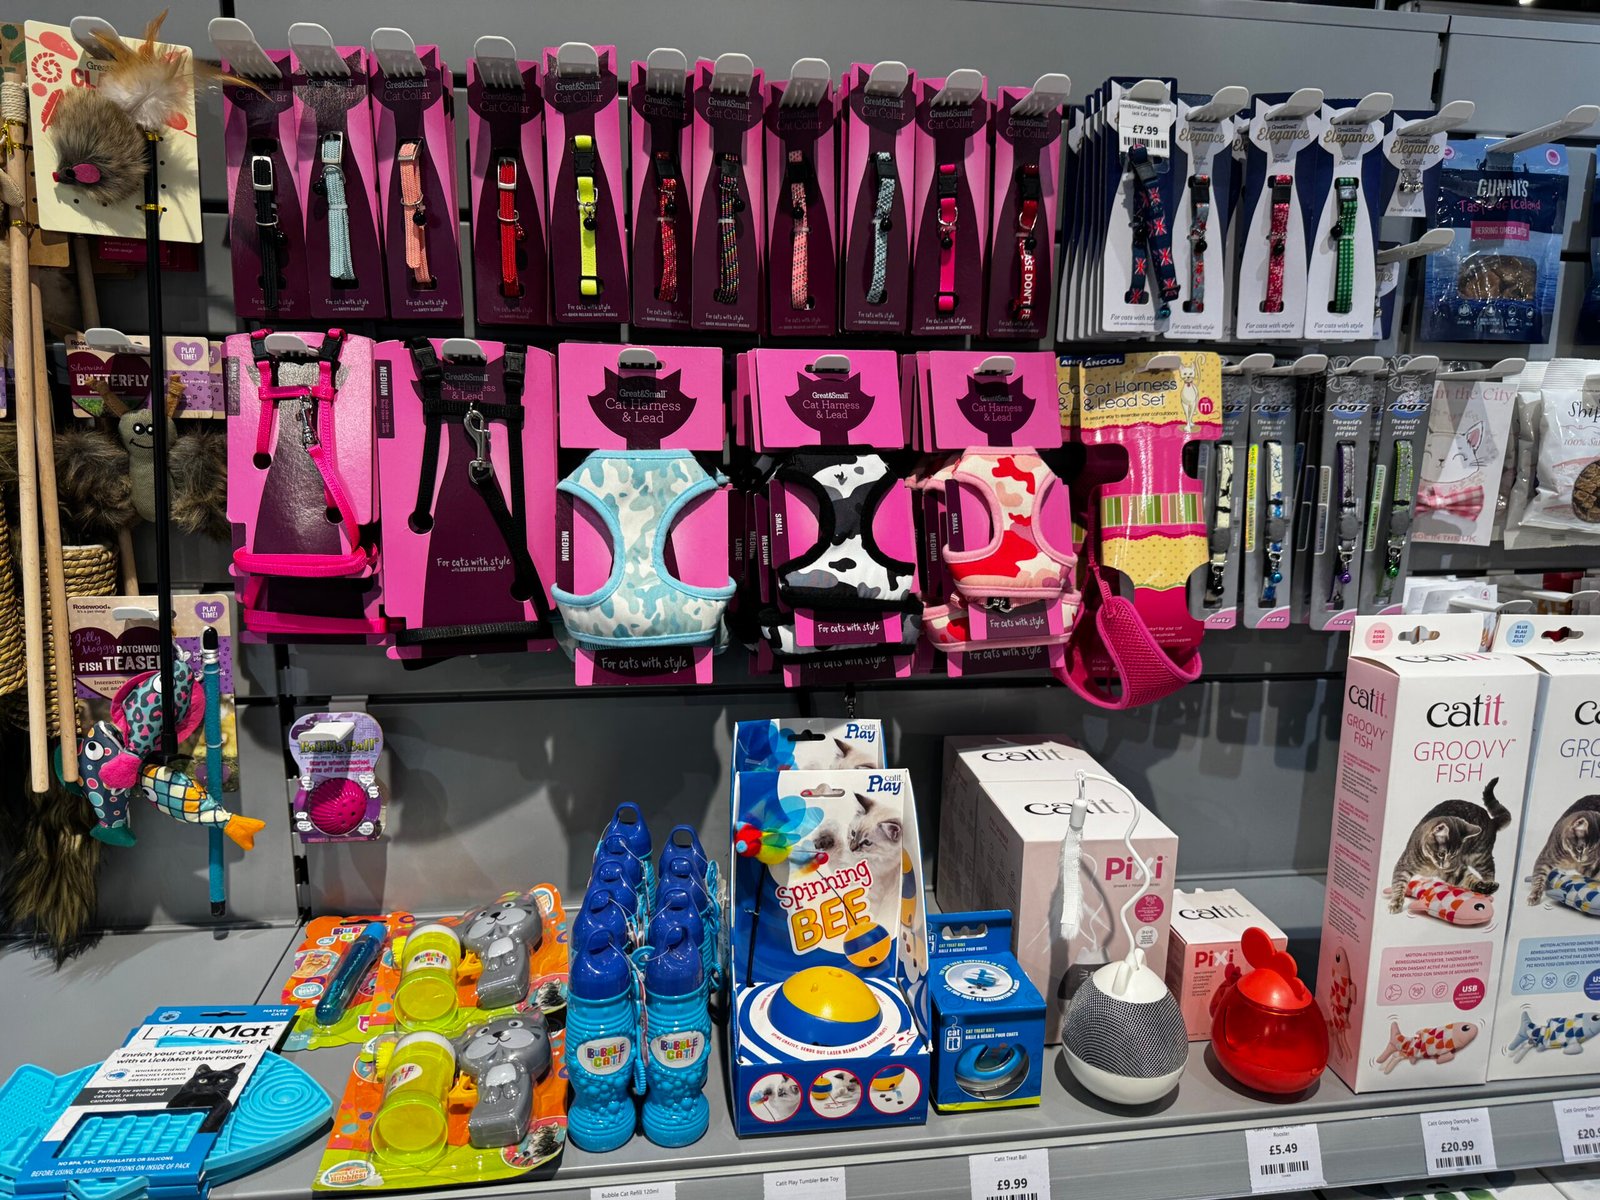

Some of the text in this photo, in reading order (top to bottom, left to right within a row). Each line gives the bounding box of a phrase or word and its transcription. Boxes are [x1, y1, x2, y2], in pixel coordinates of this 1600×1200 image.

[385, 78, 427, 89] Great&Small
[384, 90, 431, 100] Cat Collar
[554, 92, 603, 104] Cat Collar
[930, 109, 973, 118] Great&Small
[1133, 125, 1159, 136] £7.99
[1178, 128, 1225, 144] Elegance
[1257, 127, 1310, 144] Elegance
[1324, 130, 1375, 147] Elegance
[1390, 140, 1440, 158] Elegance
[1477, 178, 1529, 198] GUNNI'S
[1023, 274, 1033, 305] DON'T
[1282, 322, 1295, 330] style
[180, 353, 197, 361] TIME!
[1084, 358, 1123, 367] ANCOL
[619, 388, 667, 399] Great&Small
[1084, 380, 1178, 396] Cat Harness
[452, 391, 484, 401] & Lead
[812, 392, 849, 400] Great&Small
[1084, 394, 1166, 411] & Lead Set
[1455, 387, 1477, 400] the
[1482, 387, 1516, 405] City
[605, 398, 681, 411] Cat Harness
[802, 400, 860, 410] Cat Harness
[971, 403, 1023, 413] Cat Harness
[1252, 403, 1294, 413] rogz
[1327, 403, 1370, 413] rogz
[1387, 403, 1429, 413] rogz
[622, 411, 665, 424] & Lead
[816, 410, 848, 419] & Lead
[984, 412, 1013, 422] & Lead
[775, 513, 783, 536] SMALL
[562, 530, 570, 562] MEDIUM
[930, 532, 938, 562] MEDIUM
[437, 556, 511, 572] For cats with style
[990, 617, 1045, 629] For cats with style
[1210, 616, 1231, 624] catz
[818, 622, 880, 635] For cats with style
[74, 631, 101, 647] Jolly
[79, 656, 161, 672] FISH TEASE
[602, 656, 688, 674] For cats with style
[1349, 684, 1387, 717] catit
[1427, 694, 1505, 728] catit
[845, 724, 876, 743] Play
[1347, 713, 1385, 741] GROOVY
[1354, 732, 1374, 751] FISH
[982, 748, 1067, 762] catit
[1414, 739, 1512, 762] GROOVY
[1436, 763, 1483, 783] FISH
[867, 775, 902, 796] Play
[776, 860, 872, 910] Spinning
[1179, 905, 1243, 920] catit
[791, 888, 871, 952] BEE
[1462, 985, 1478, 993] USB
[142, 1025, 274, 1041] LickiMat
[947, 1029, 960, 1037] cat
[661, 1037, 698, 1051] BUBBLE
[157, 1051, 177, 1059] your
[204, 1048, 244, 1056] Feeding
[587, 1043, 625, 1059] BUBBLE
[667, 1048, 695, 1060] CAT!
[148, 1056, 189, 1064] LickiMat
[593, 1054, 623, 1068] CAT!
[1269, 1143, 1298, 1156] £5.49
[1441, 1140, 1474, 1153] £20.99
[788, 1179, 799, 1187] Play
[799, 1177, 820, 1185] Tumbler
[830, 1176, 840, 1184] Toy
[997, 1178, 1028, 1191] £9.99
[601, 1191, 620, 1199] Bubble
[644, 1188, 660, 1196] 120ml
